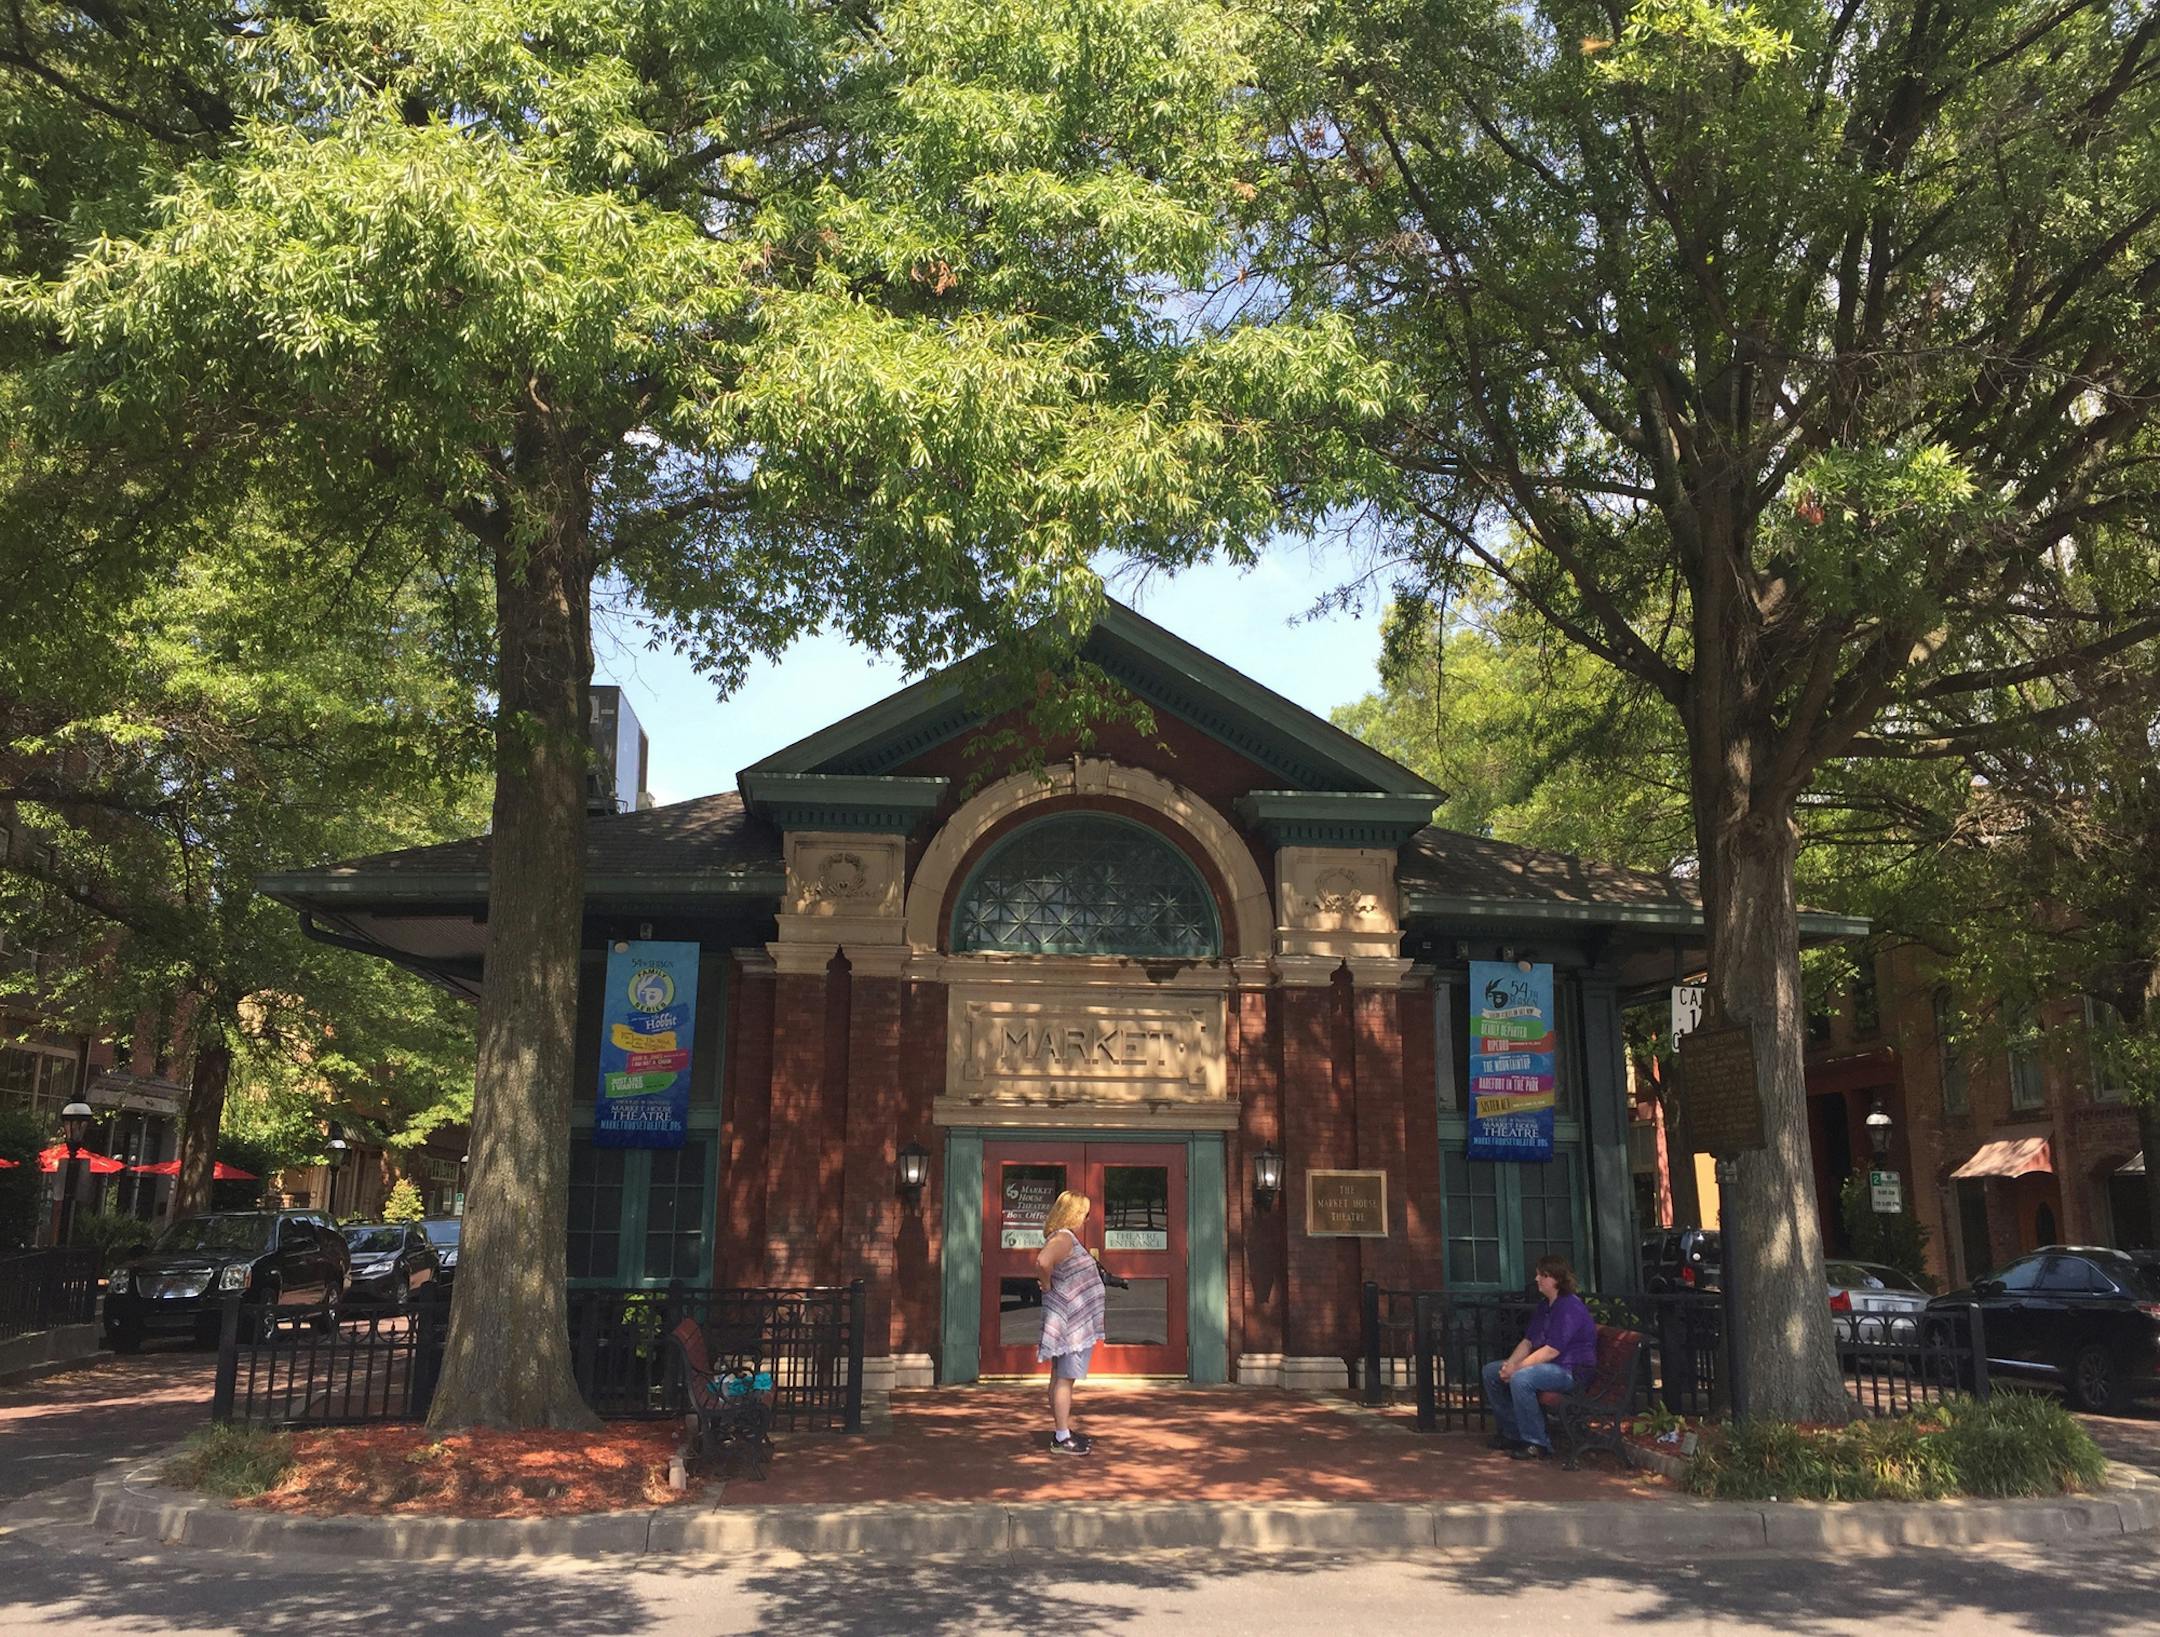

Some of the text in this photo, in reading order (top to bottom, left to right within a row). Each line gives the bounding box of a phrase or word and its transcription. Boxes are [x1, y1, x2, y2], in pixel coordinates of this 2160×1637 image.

[637, 967, 668, 978] FAMILY
[635, 1002, 667, 1012] SERIES
[646, 1012, 678, 1030] Hobbit
[1500, 1024, 1528, 1039] DEPARTED
[1000, 1026, 1175, 1065] MARKET
[1483, 1057, 1531, 1072] THE MOUNTAINTOP
[1478, 1077, 1538, 1092] BAREFOOT IN THE PARK
[611, 1111, 673, 1121] THEATRE
[1515, 1122, 1538, 1130] HOUSE
[1484, 1128, 1539, 1138] THEATRE
[1873, 1176, 1879, 1184] 2
[1020, 1185, 1052, 1194] MARKET
[1339, 1185, 1355, 1195] THE
[1018, 1193, 1042, 1201] HOUSE
[1017, 1202, 1050, 1210] THEATRE
[1317, 1199, 1377, 1208] MARKET HOUSE
[1006, 1210, 1049, 1220] Box Offic
[1331, 1212, 1364, 1222] THEATRE
[1114, 1232, 1157, 1240] THEATRE
[1110, 1240, 1160, 1248] ENTRANCE
